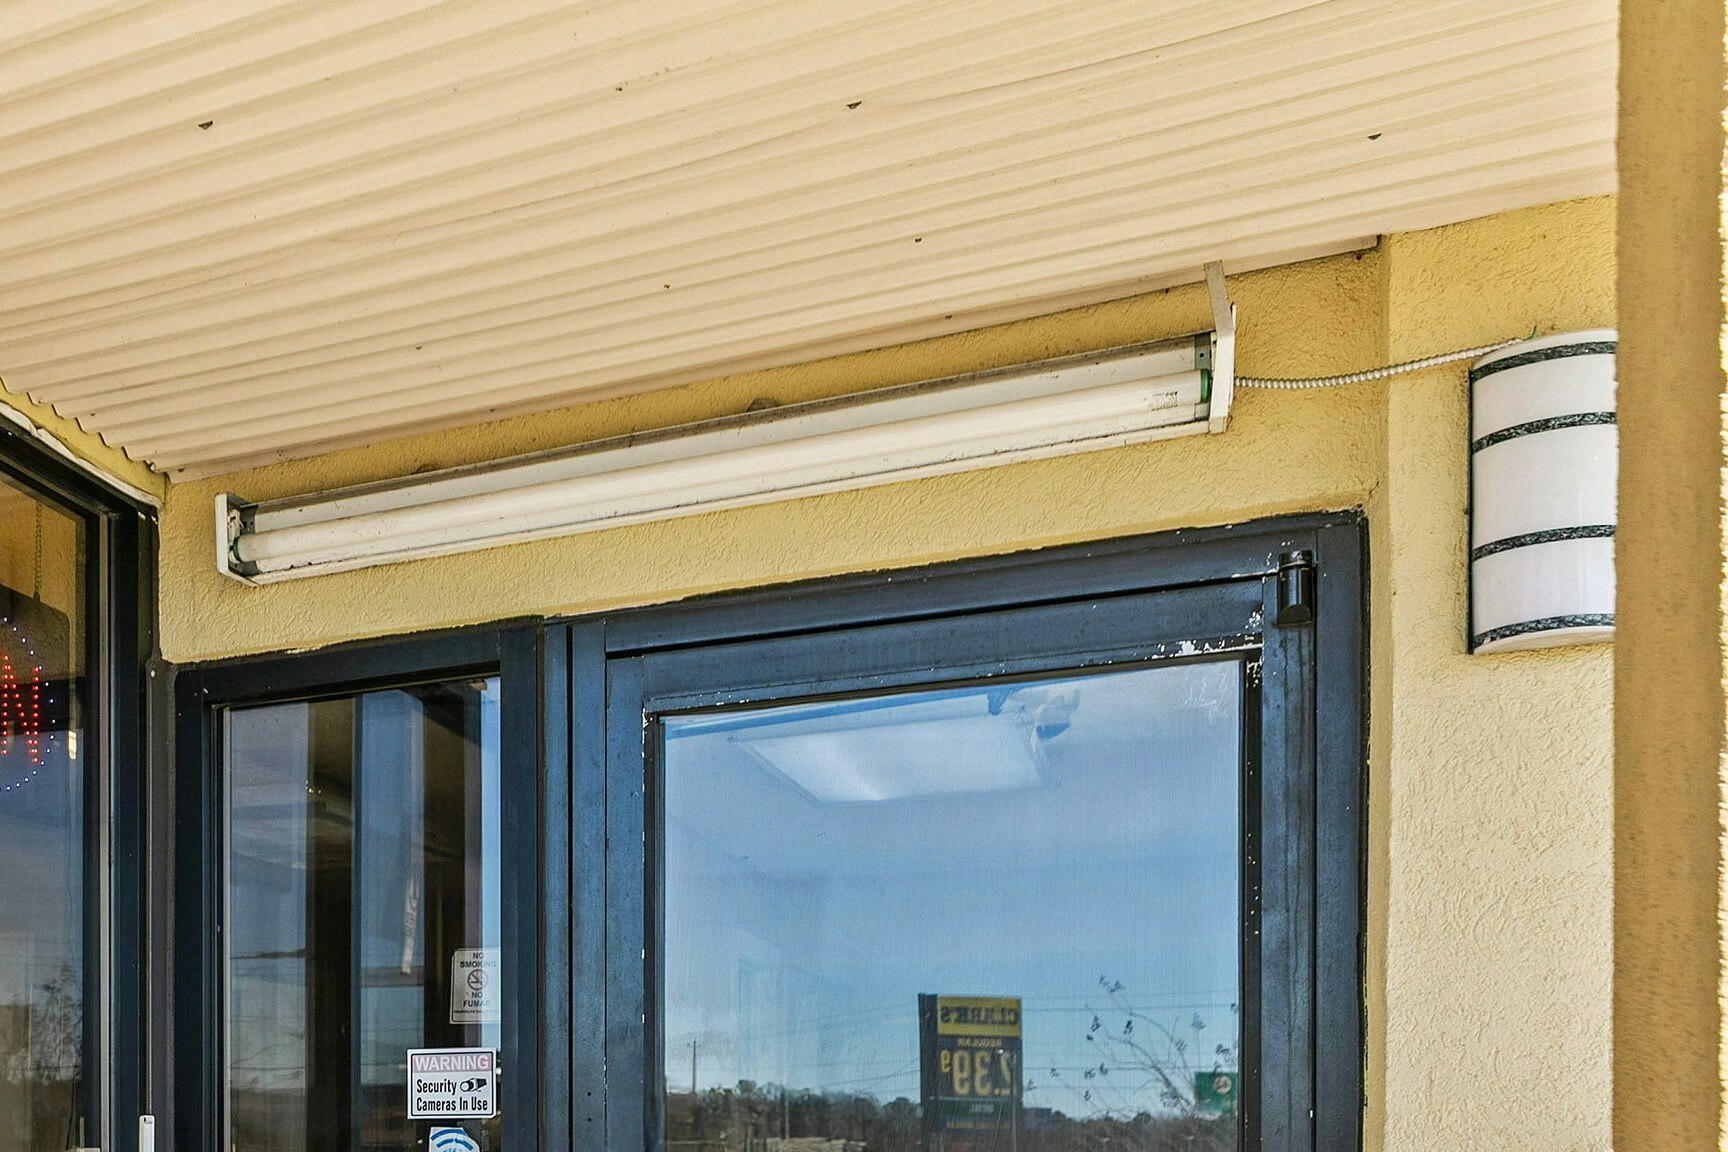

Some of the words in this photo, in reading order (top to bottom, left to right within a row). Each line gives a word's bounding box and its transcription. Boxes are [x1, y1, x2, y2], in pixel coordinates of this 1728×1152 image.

[472, 952, 484, 960] NO
[459, 960, 497, 968] SMOKING
[471, 991, 483, 999] NO
[462, 1000, 492, 1008] FUMAR
[415, 1055, 490, 1071] WARNING
[416, 1078, 457, 1096] Security
[416, 1097, 457, 1112] Cameras
[459, 1096, 468, 1111] In
[471, 1096, 488, 1111] Use
